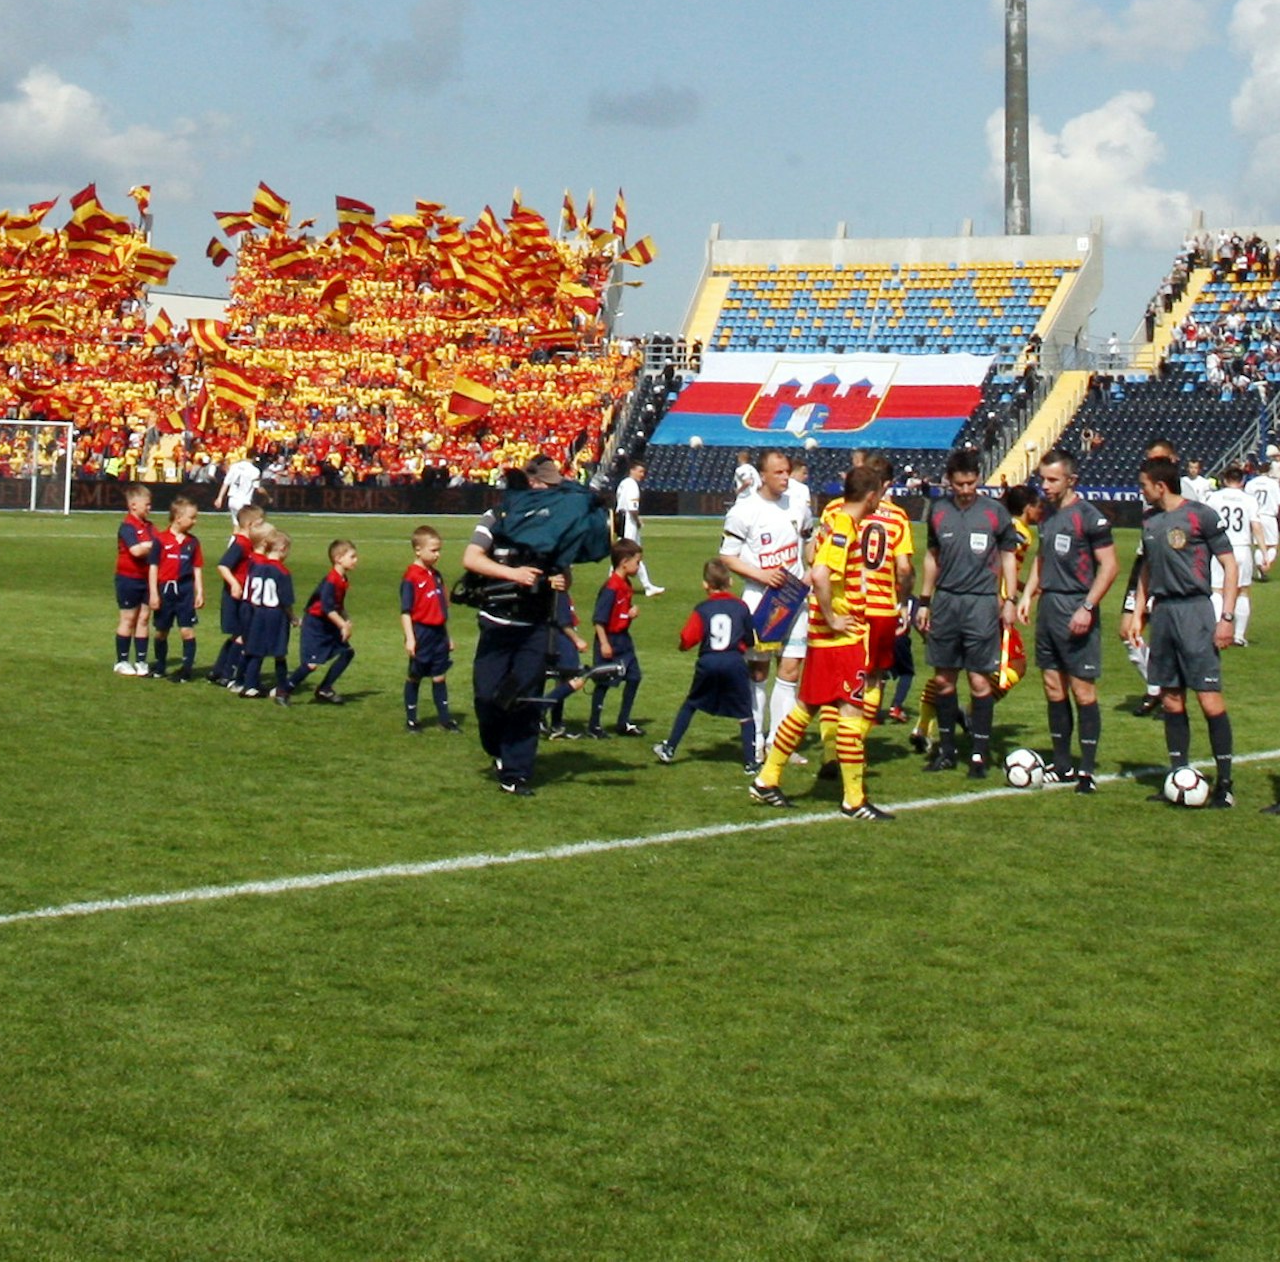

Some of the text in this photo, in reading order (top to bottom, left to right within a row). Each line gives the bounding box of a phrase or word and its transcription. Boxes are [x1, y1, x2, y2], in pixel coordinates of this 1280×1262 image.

[1221, 506, 1243, 532] 33
[250, 576, 280, 607] 20
[710, 614, 732, 650] 9
